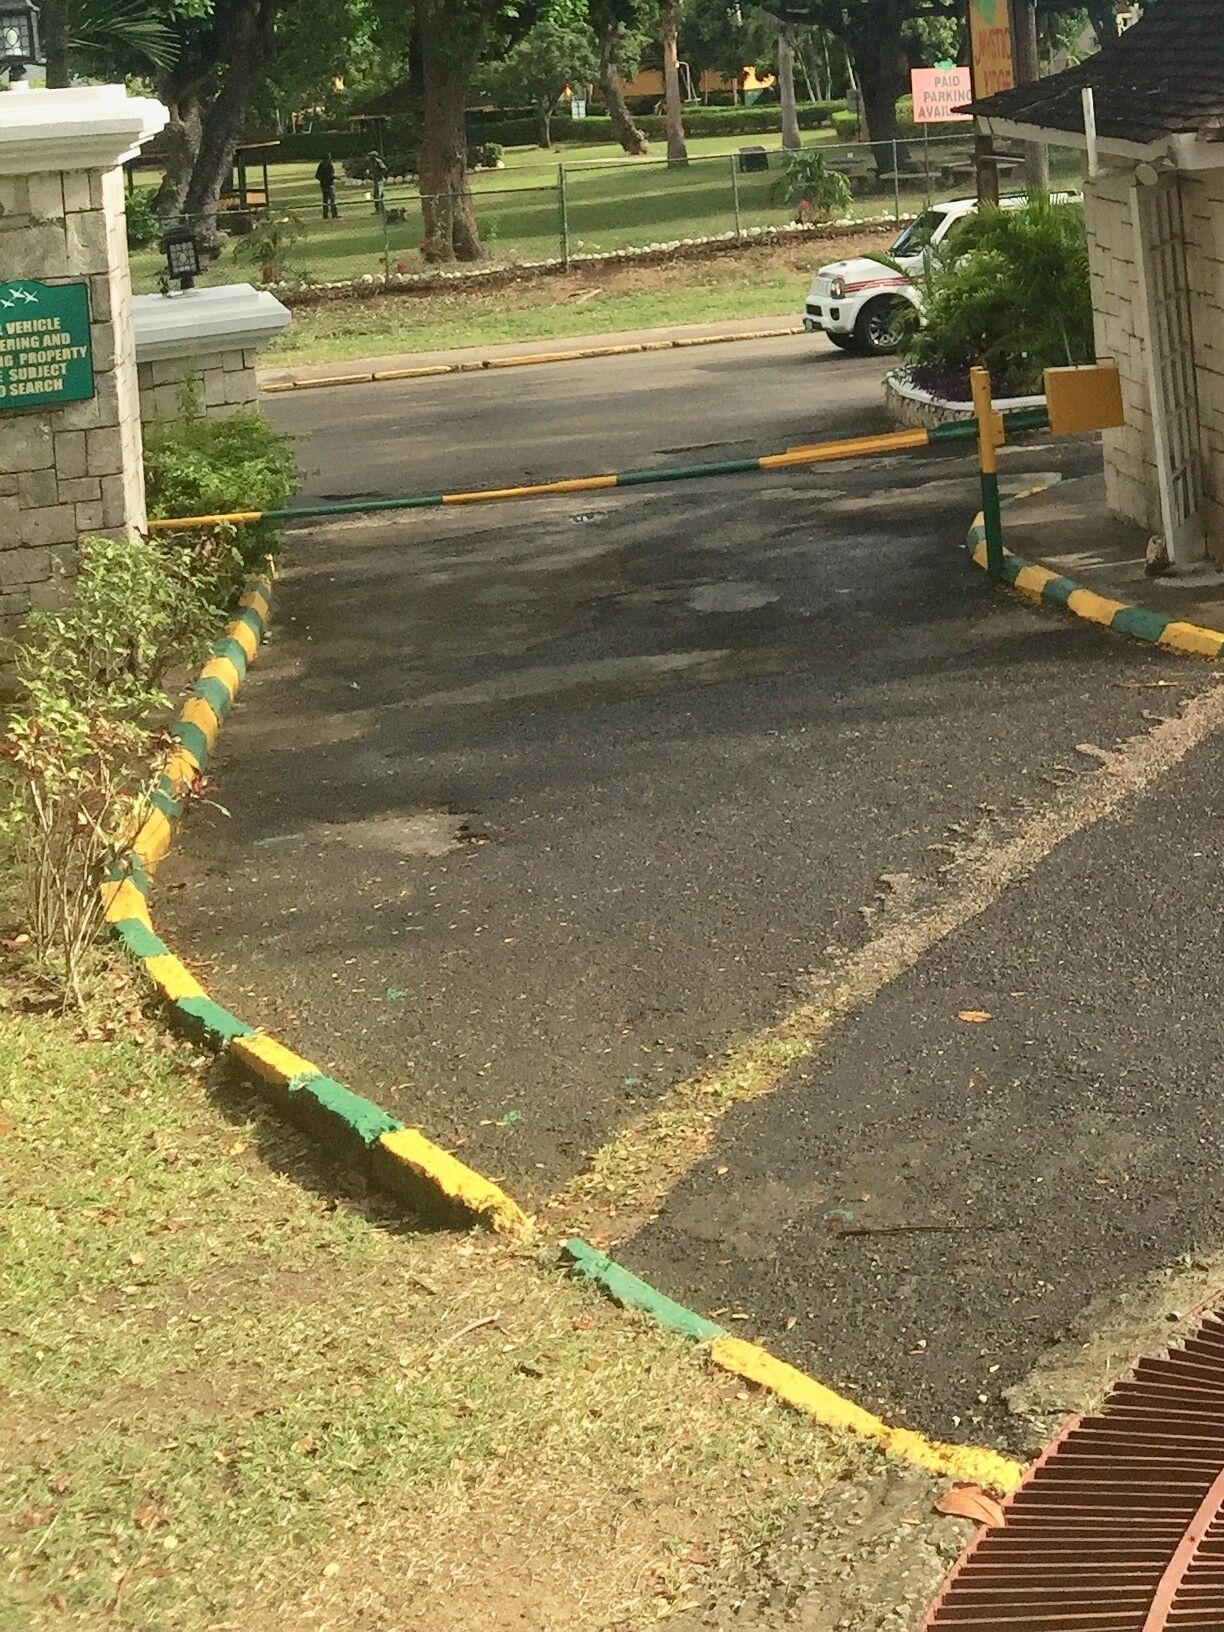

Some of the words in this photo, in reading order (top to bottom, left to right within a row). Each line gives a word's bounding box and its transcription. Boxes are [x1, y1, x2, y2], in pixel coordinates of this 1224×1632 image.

[934, 75, 960, 87] PAID
[918, 105, 961, 118] AVAIL
[6, 317, 61, 335] VEHICLE
[43, 332, 71, 347] AND
[19, 345, 87, 366] PROPERTY
[8, 363, 67, 382] SUBJECT
[9, 378, 63, 396] SEARCH
